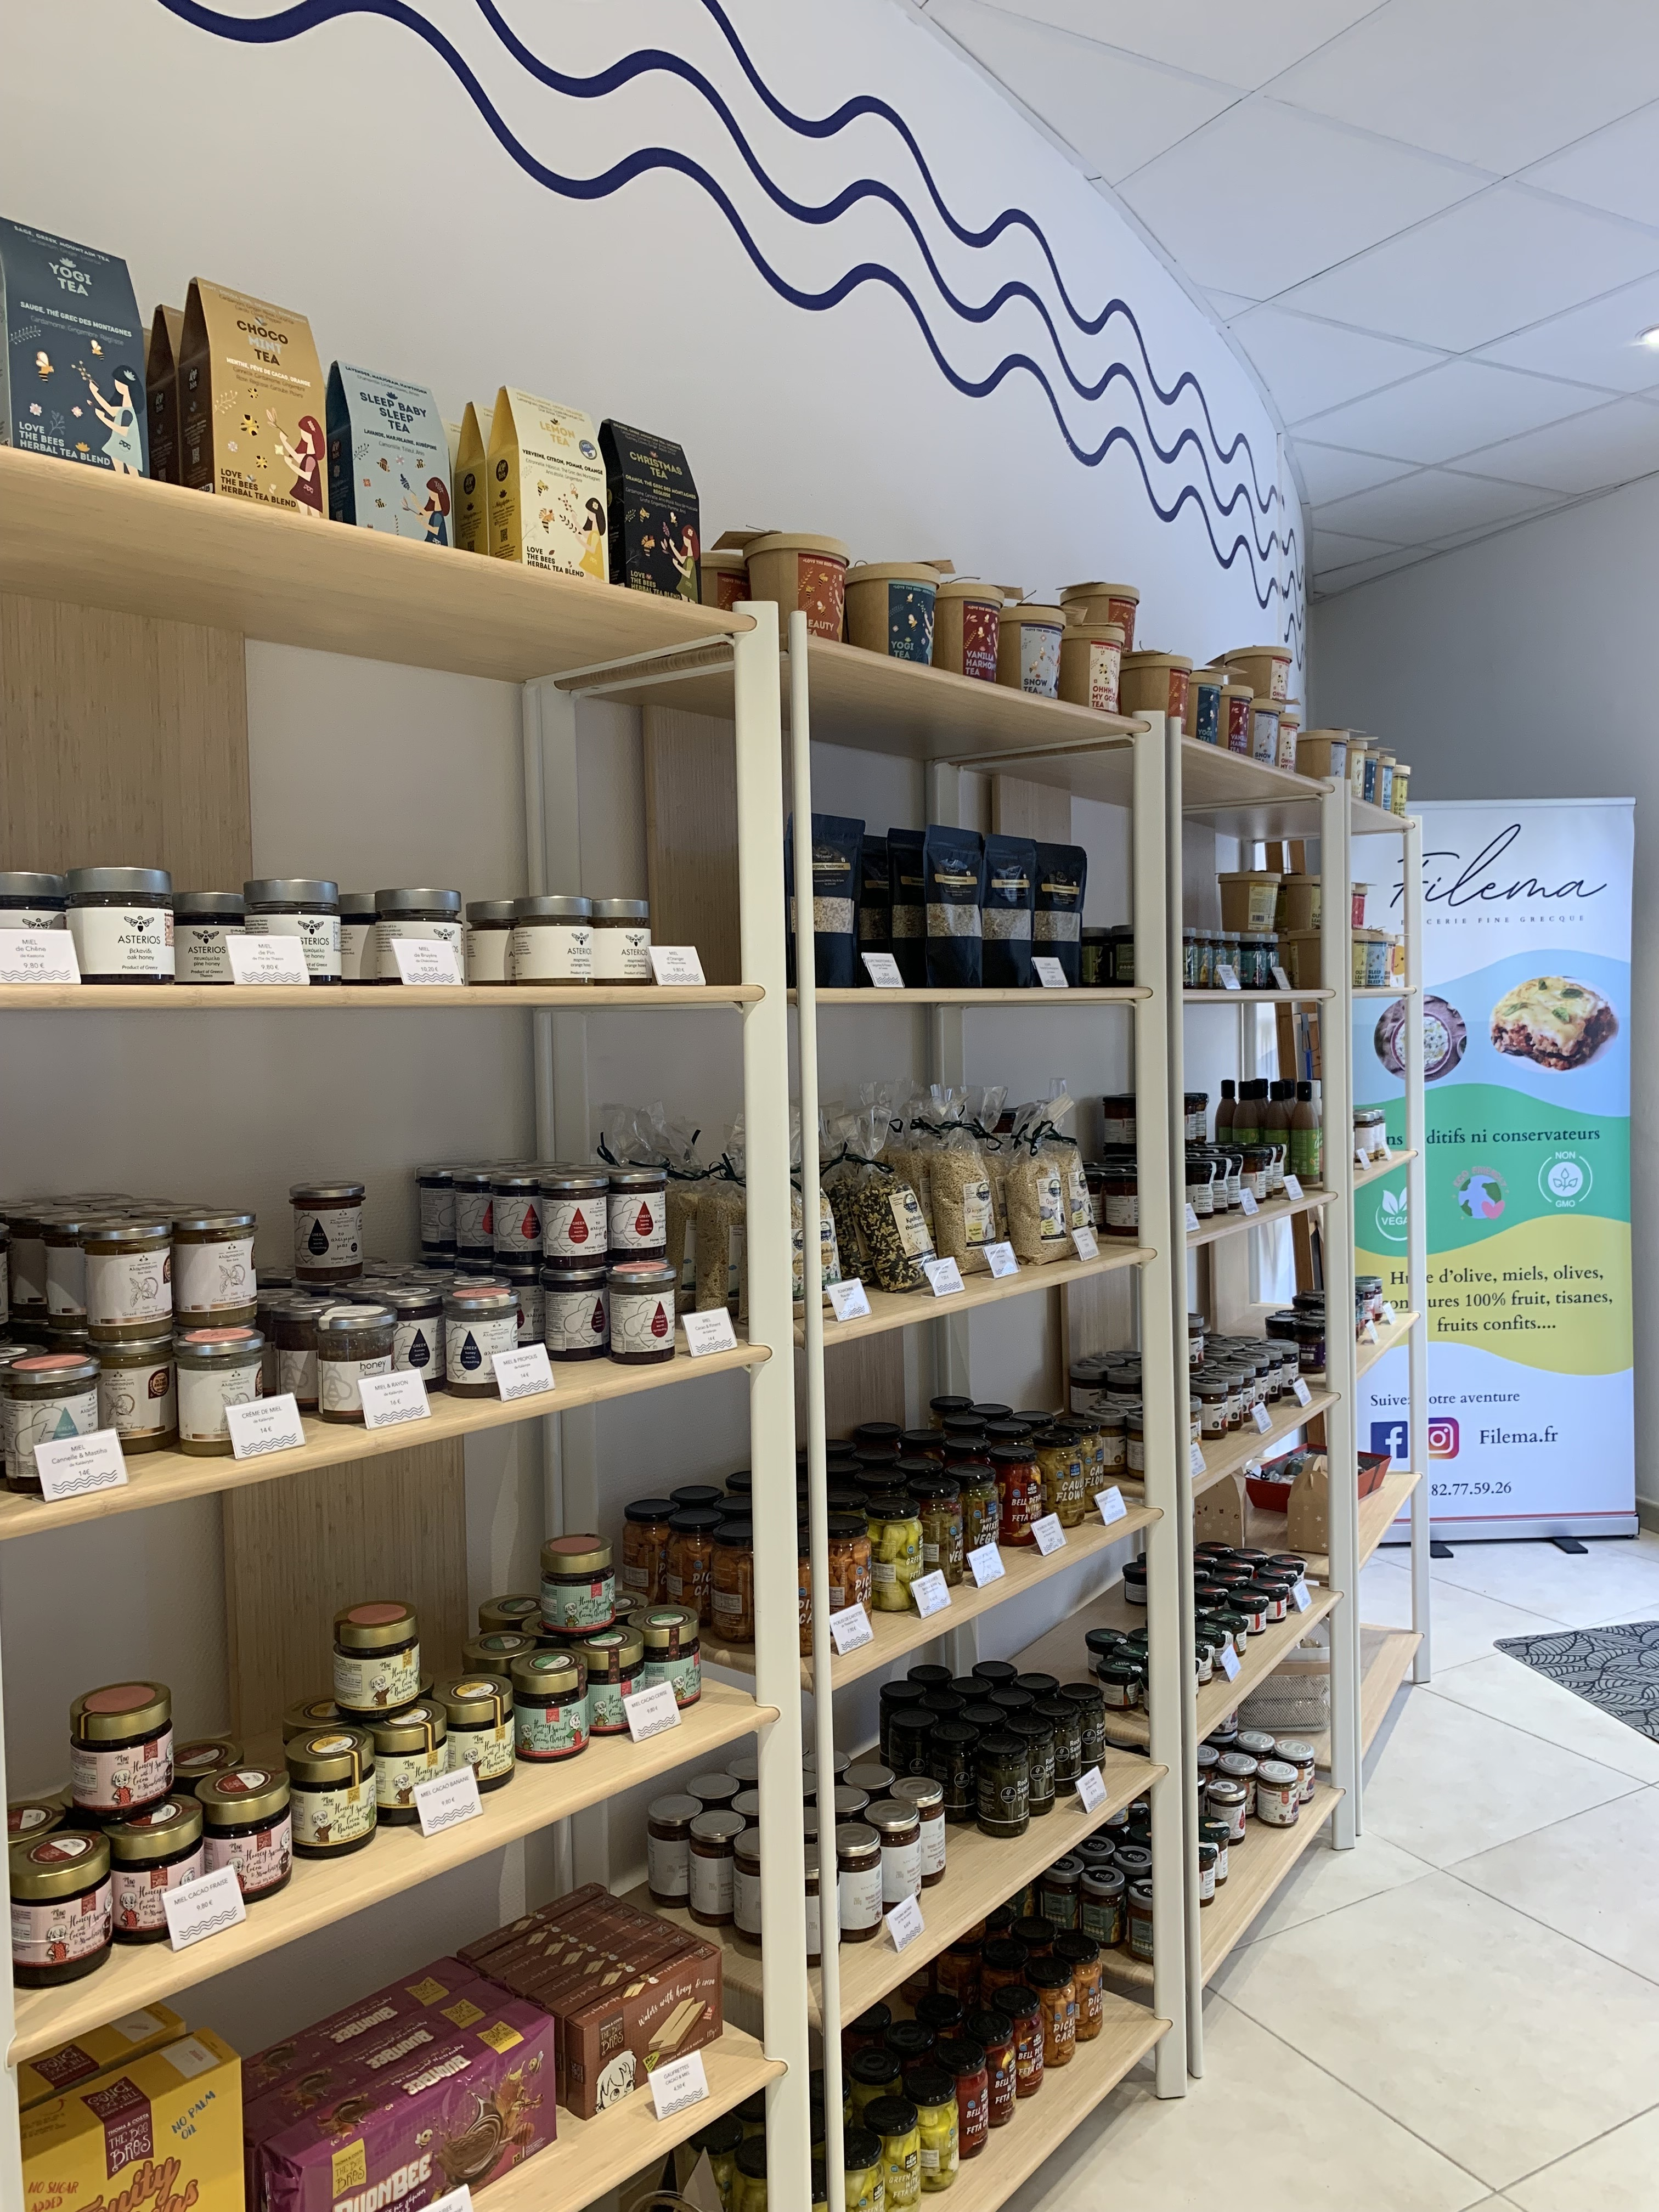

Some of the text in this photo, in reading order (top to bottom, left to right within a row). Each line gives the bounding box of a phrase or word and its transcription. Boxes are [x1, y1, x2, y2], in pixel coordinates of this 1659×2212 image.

[48, 262, 92, 285] YOGI
[57, 277, 88, 296] TEA
[20, 302, 132, 337] SAUGE, THÉ GREC DES MONTAGNES
[237, 320, 288, 345] CHOCO
[249, 336, 281, 354] MINT
[255, 349, 280, 366] TEA
[226, 357, 249, 369] MENTHE,
[290, 377, 311, 387] ORANGE
[360, 392, 426, 417] SLEEP BABY
[379, 407, 414, 422] SLEEP
[19, 422, 44, 434] LOVE
[388, 420, 410, 433] TEA
[540, 421, 575, 439] LEMON
[19, 431, 64, 447] THE BEES
[550, 434, 570, 447] TEA
[20, 440, 110, 466] HERBAL TEA BLEND
[522, 449, 545, 460] VERVEINE,
[546, 456, 565, 465] CITRON,
[585, 466, 603, 475] ORANGE
[630, 452, 682, 475] CHRISTMAS
[221, 469, 242, 479] LOVE
[650, 467, 668, 479] TEA
[221, 476, 258, 491] THE BEES
[221, 485, 296, 507] HERBAL TEA BLEND
[527, 546, 543, 555] LOVE
[527, 553, 555, 565] THE BEES
[527, 560, 551, 570] HERBAL
[565, 568, 584, 577] BLEND
[891, 641, 914, 651] YOGI
[894, 650, 910, 659] TEA
[966, 650, 994, 662] VANILLA
[965, 667, 980, 676] TEA
[1024, 686, 1038, 694] TEA
[117, 935, 161, 944] ASTERIOS
[1426, 1128, 1465, 1144] ditifs
[1471, 1130, 1487, 1143] ni
[1493, 1127, 1600, 1142] conservateurs
[1381, 1217, 1407, 1226] VEGA
[1502, 1265, 1548, 1282] miels,
[1553, 1263, 1604, 1281] olives,
[1465, 1292, 1506, 1307] 100%
[1511, 1290, 1550, 1307] fruit,
[1555, 1291, 1613, 1306] tisanes,
[1437, 1317, 1478, 1332] fruits
[360, 1361, 386, 1372] honey
[1429, 1394, 1455, 1404] otre
[1460, 1392, 1521, 1403] aventure
[1479, 1426, 1559, 1444] Filema.fr
[52, 1455, 77, 1464] Cannelle
[85, 1448, 108, 1457] Mastiha
[1012, 1498, 1028, 1506] BELL
[1012, 1513, 1029, 1522] FETA
[131, 1760, 153, 1774] Honey
[174, 1878, 228, 1905] MIEL CACAO FRAISE
[196, 1901, 208, 1910] 9,80
[660, 1989, 675, 2007] with
[676, 1984, 692, 1997] honey
[1018, 2051, 1033, 2060] BELL
[664, 2064, 690, 2079] GAUFRETTES
[1019, 2065, 1034, 2075] FETA
[171, 2090, 216, 2134] NO PALM
[108, 2123, 126, 2136] THOMA
[132, 2112, 149, 2125] COSTA
[109, 2132, 127, 2149] THE
[110, 2135, 151, 2173] BROS
[28, 2181, 79, 2194] NO SUGAR
[31, 2196, 63, 2212] ADDED
